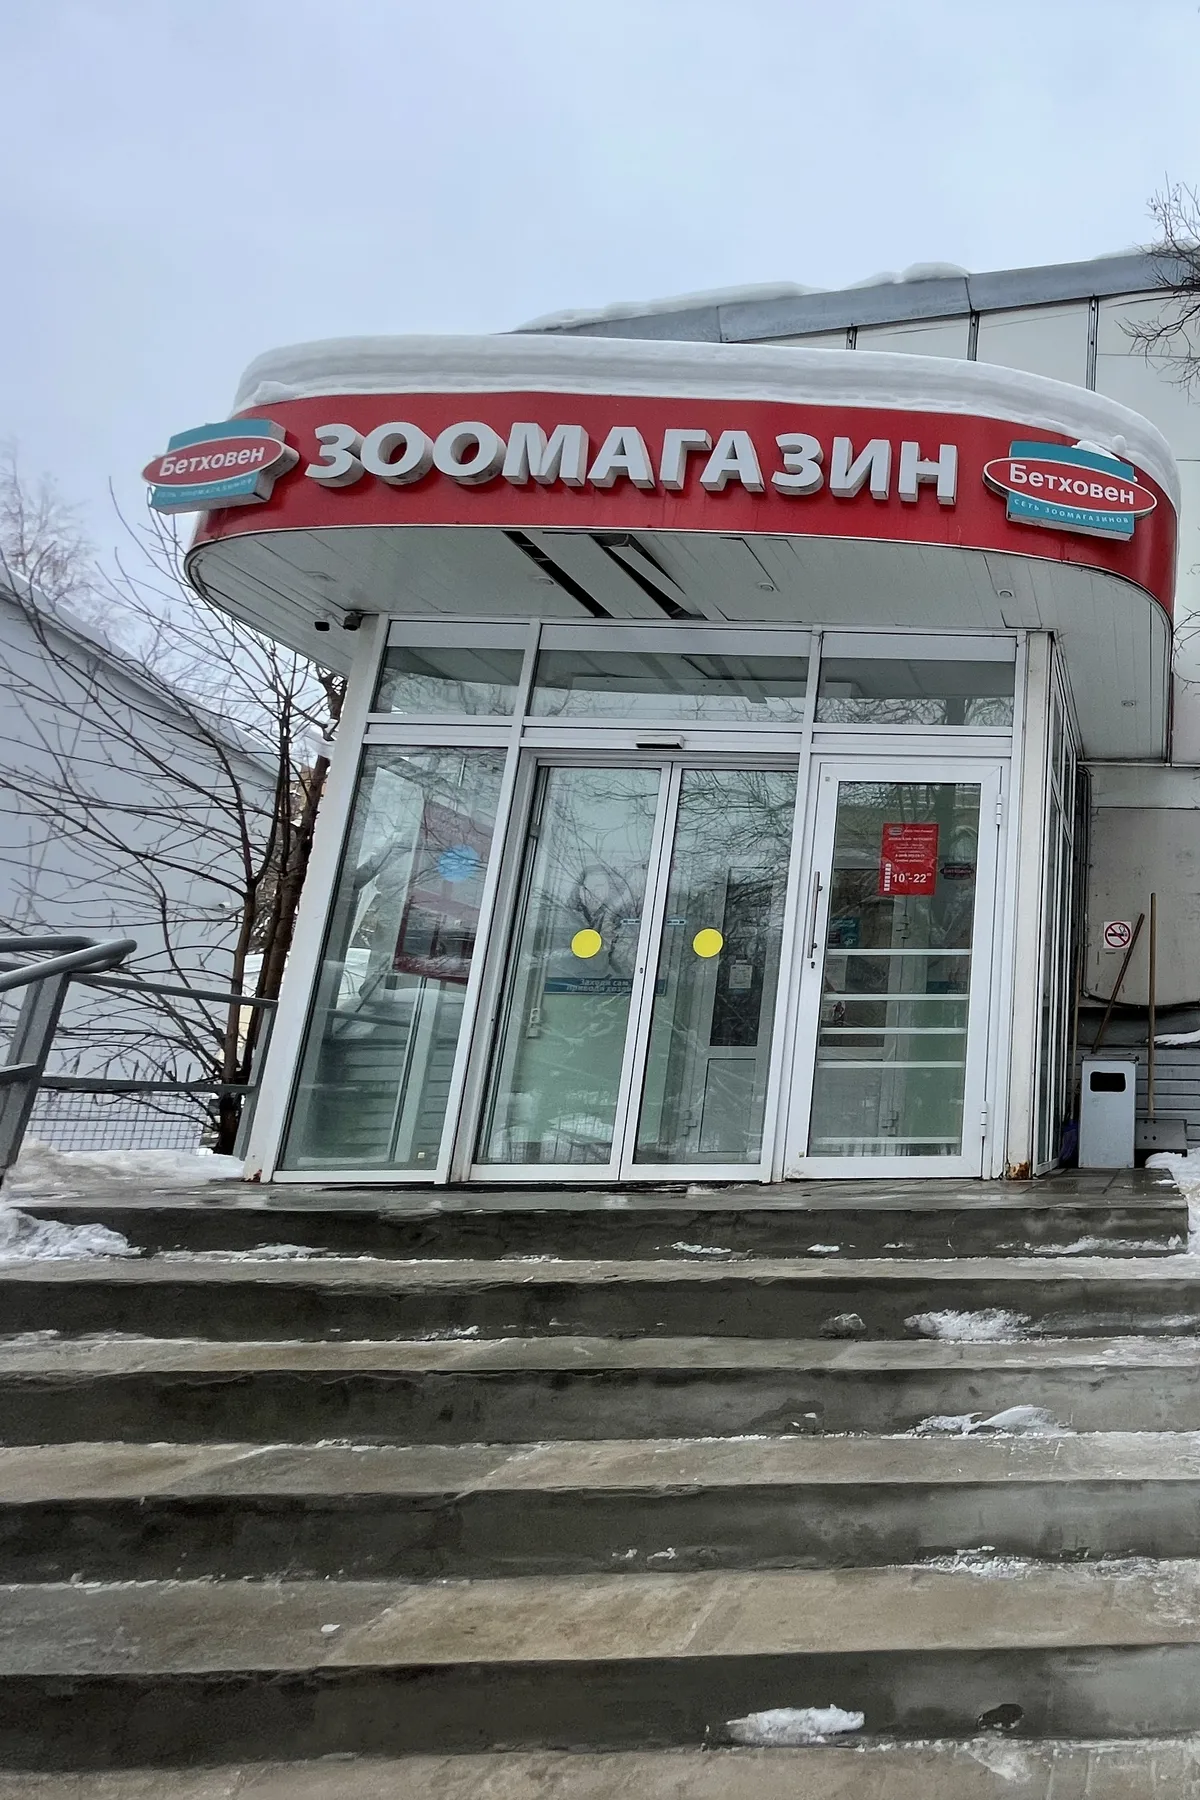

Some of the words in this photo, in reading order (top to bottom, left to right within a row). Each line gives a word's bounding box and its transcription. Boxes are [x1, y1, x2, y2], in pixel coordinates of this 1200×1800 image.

[159, 447, 265, 476] Бетховен
[304, 420, 962, 505] ЗООМАГАЗИН
[1010, 463, 1134, 505] Бетховен
[1013, 498, 1041, 512] СЕТЬ
[1045, 506, 1129, 524] ЗООМАГАЗИНОВ
